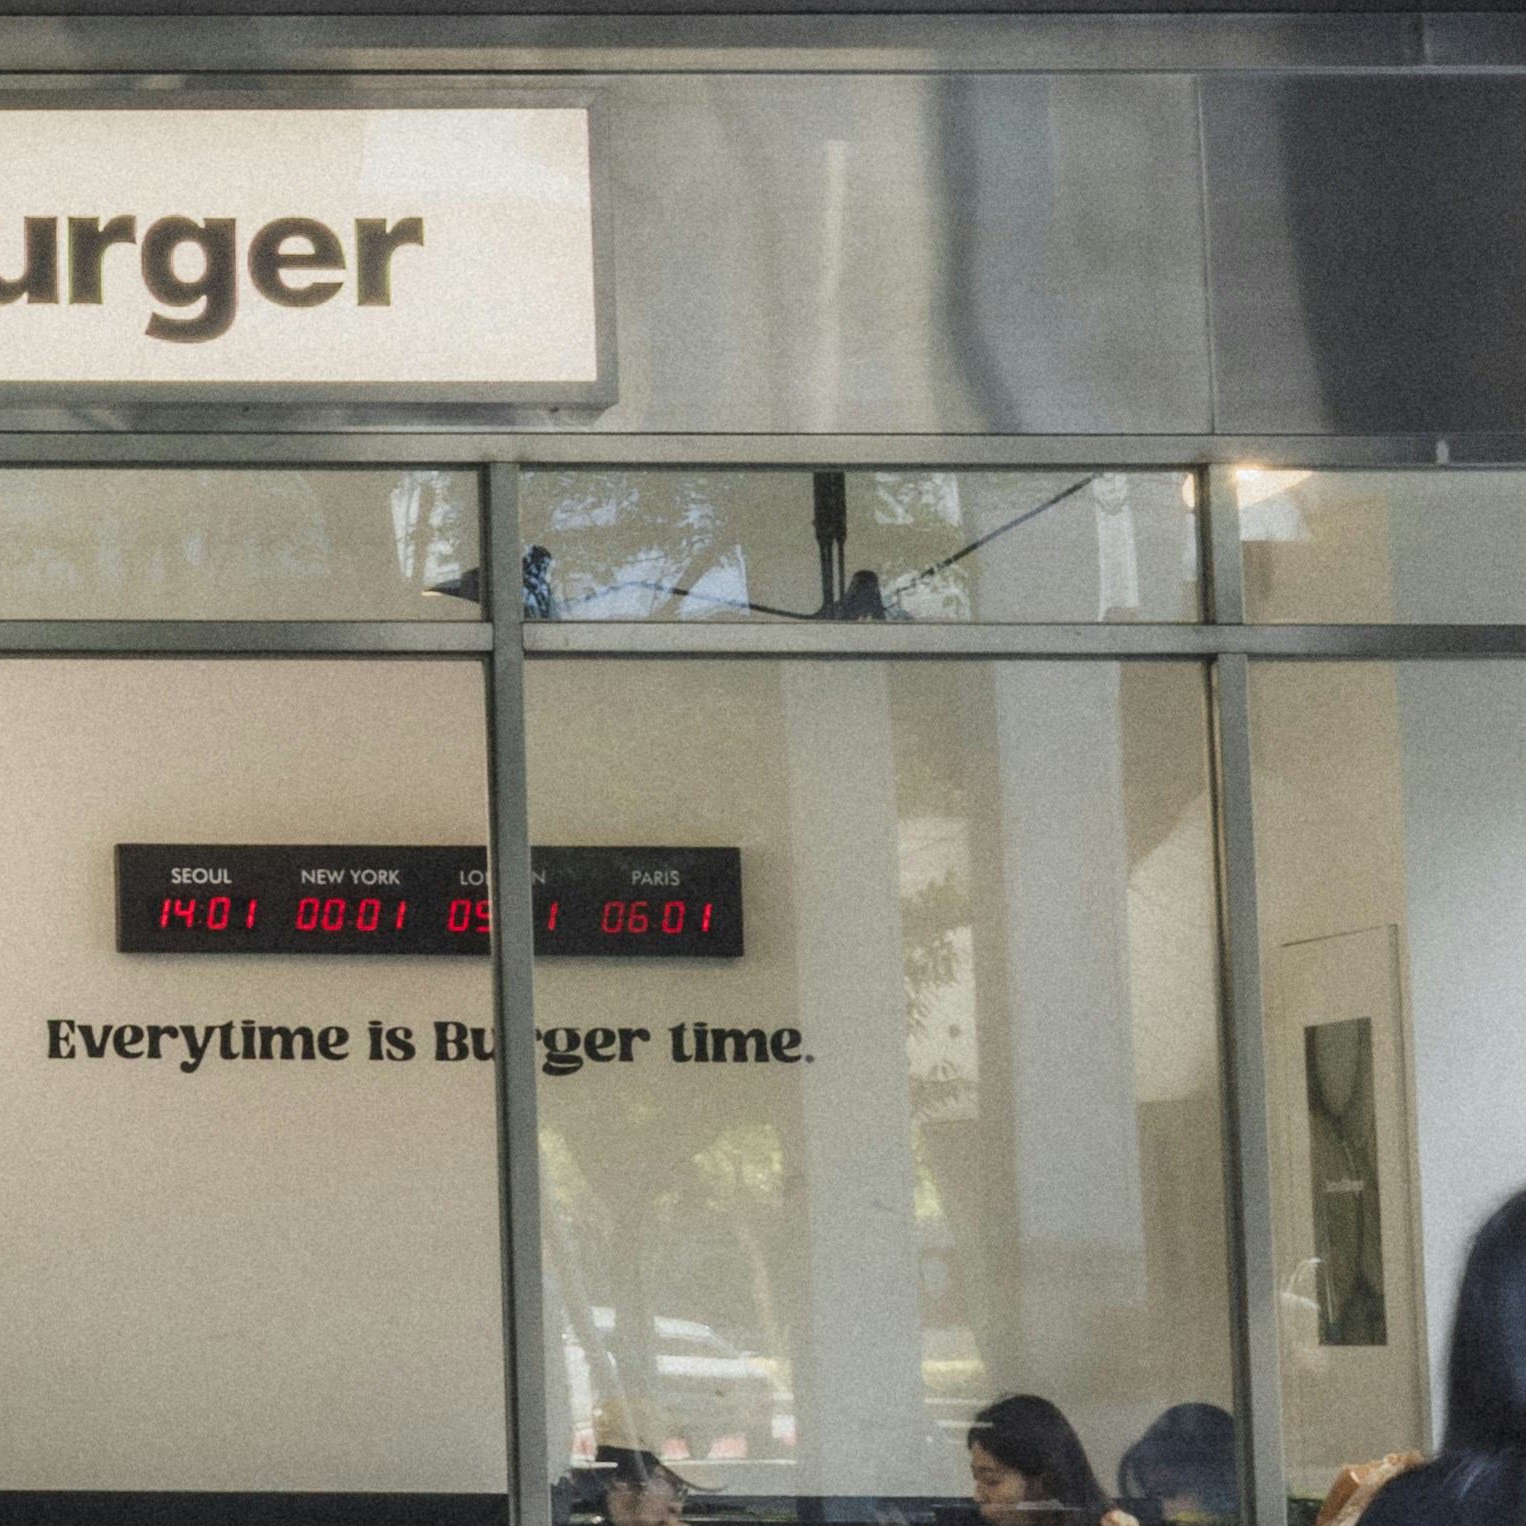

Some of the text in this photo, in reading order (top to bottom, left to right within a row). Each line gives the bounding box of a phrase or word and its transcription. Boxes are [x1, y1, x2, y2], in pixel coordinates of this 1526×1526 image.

[171, 867, 233, 885] SEOUL
[300, 869, 401, 886] NEW YORK
[631, 870, 682, 887] PARIS
[47, 1018, 814, 1077] Everytime is Buger time.
